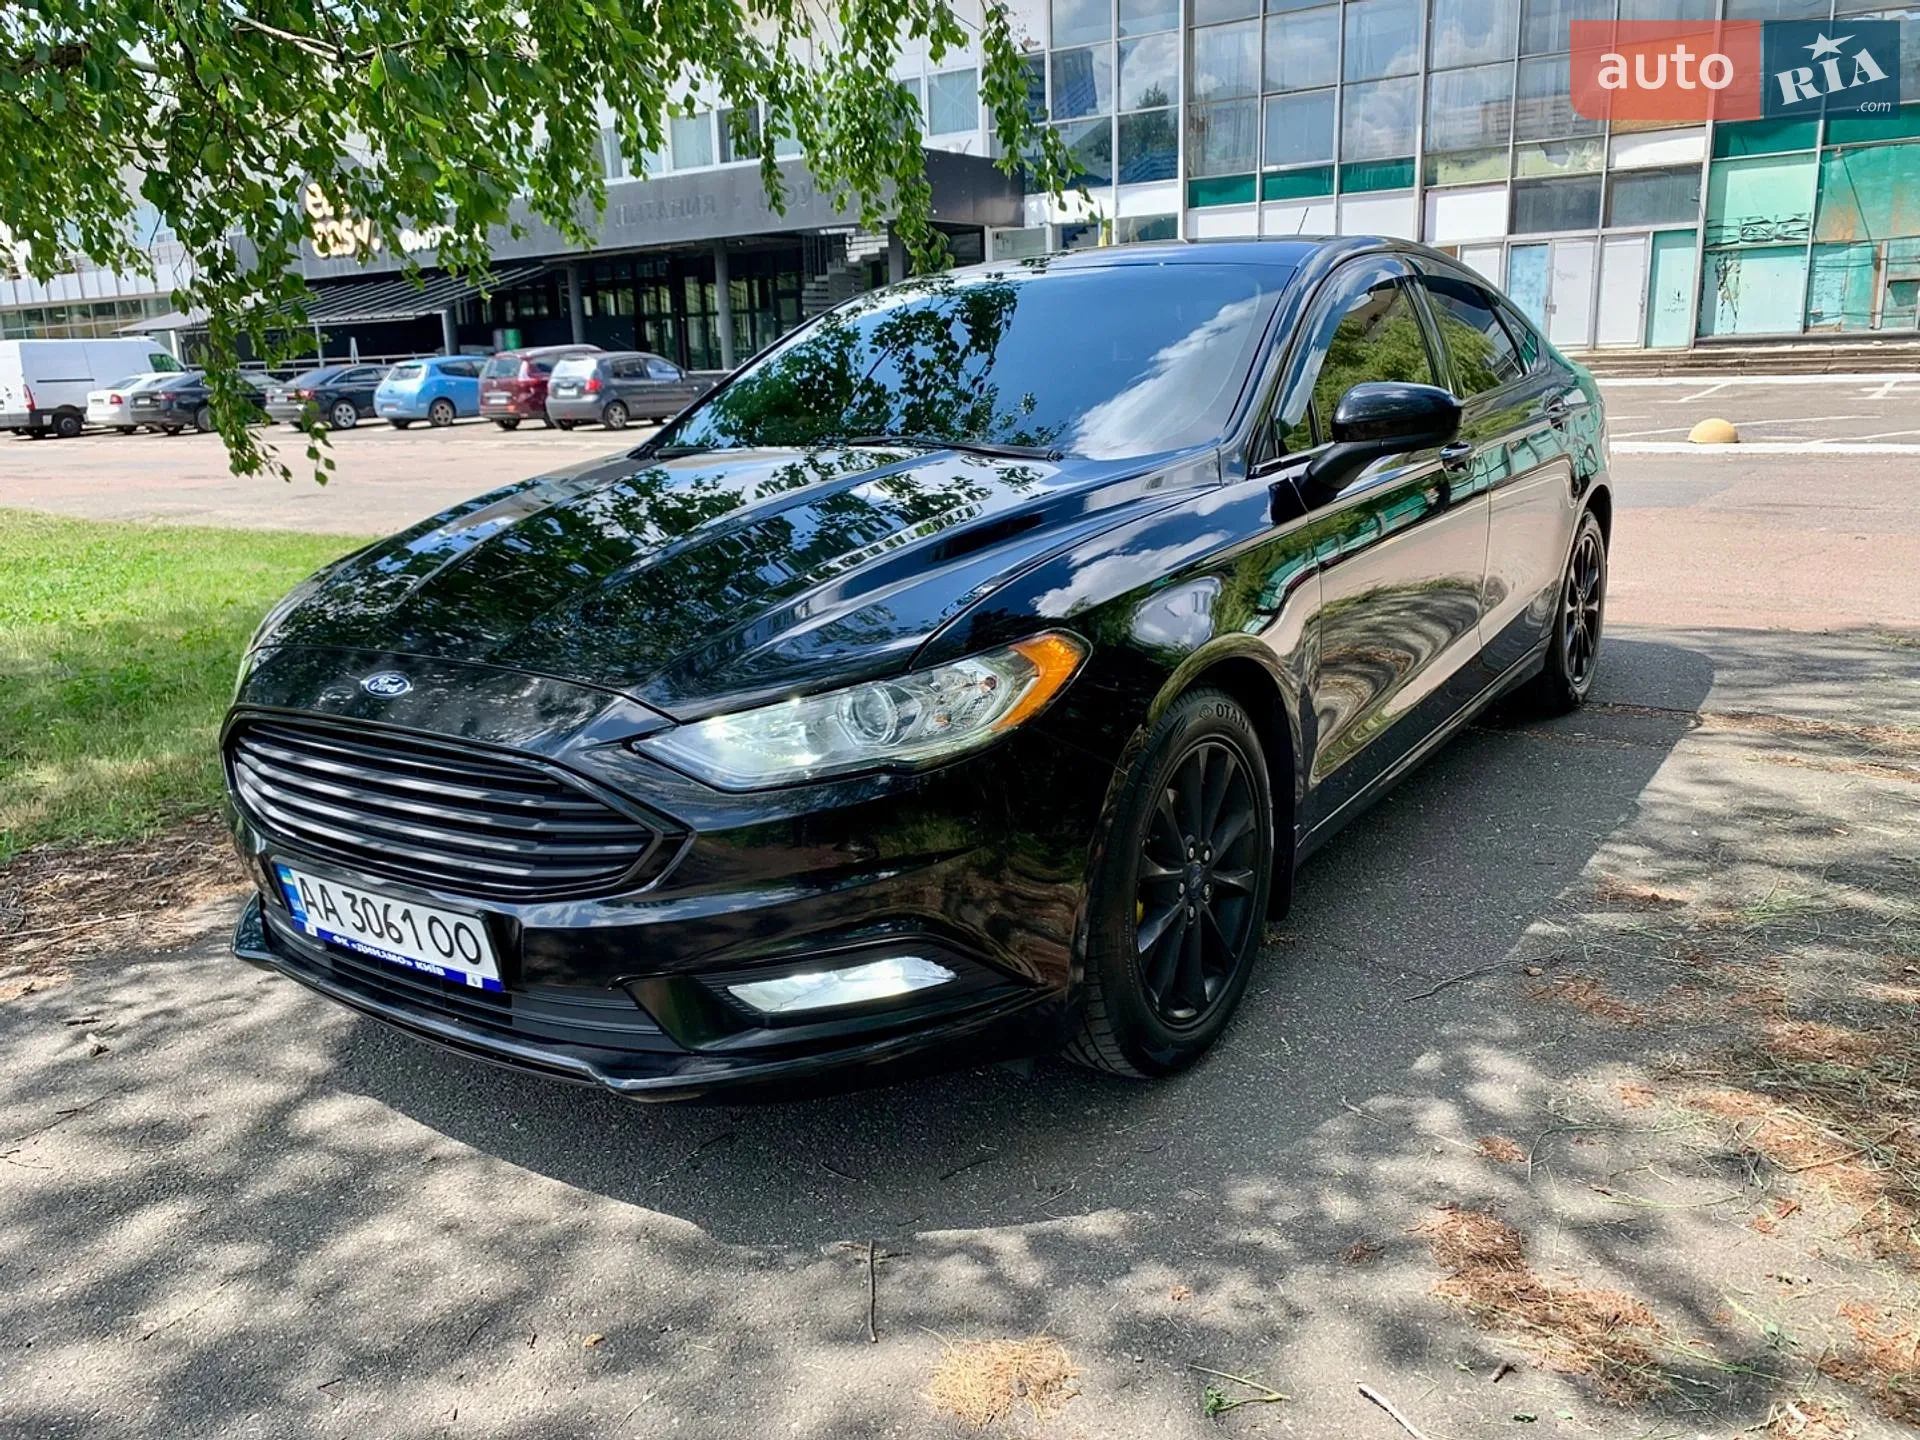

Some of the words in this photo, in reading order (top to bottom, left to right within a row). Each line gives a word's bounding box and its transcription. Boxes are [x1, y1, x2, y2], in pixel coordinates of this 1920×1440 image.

[369, 674, 405, 693] Ford
[298, 877, 345, 927] AA
[342, 890, 423, 951] 3061
[332, 935, 350, 947] ФК
